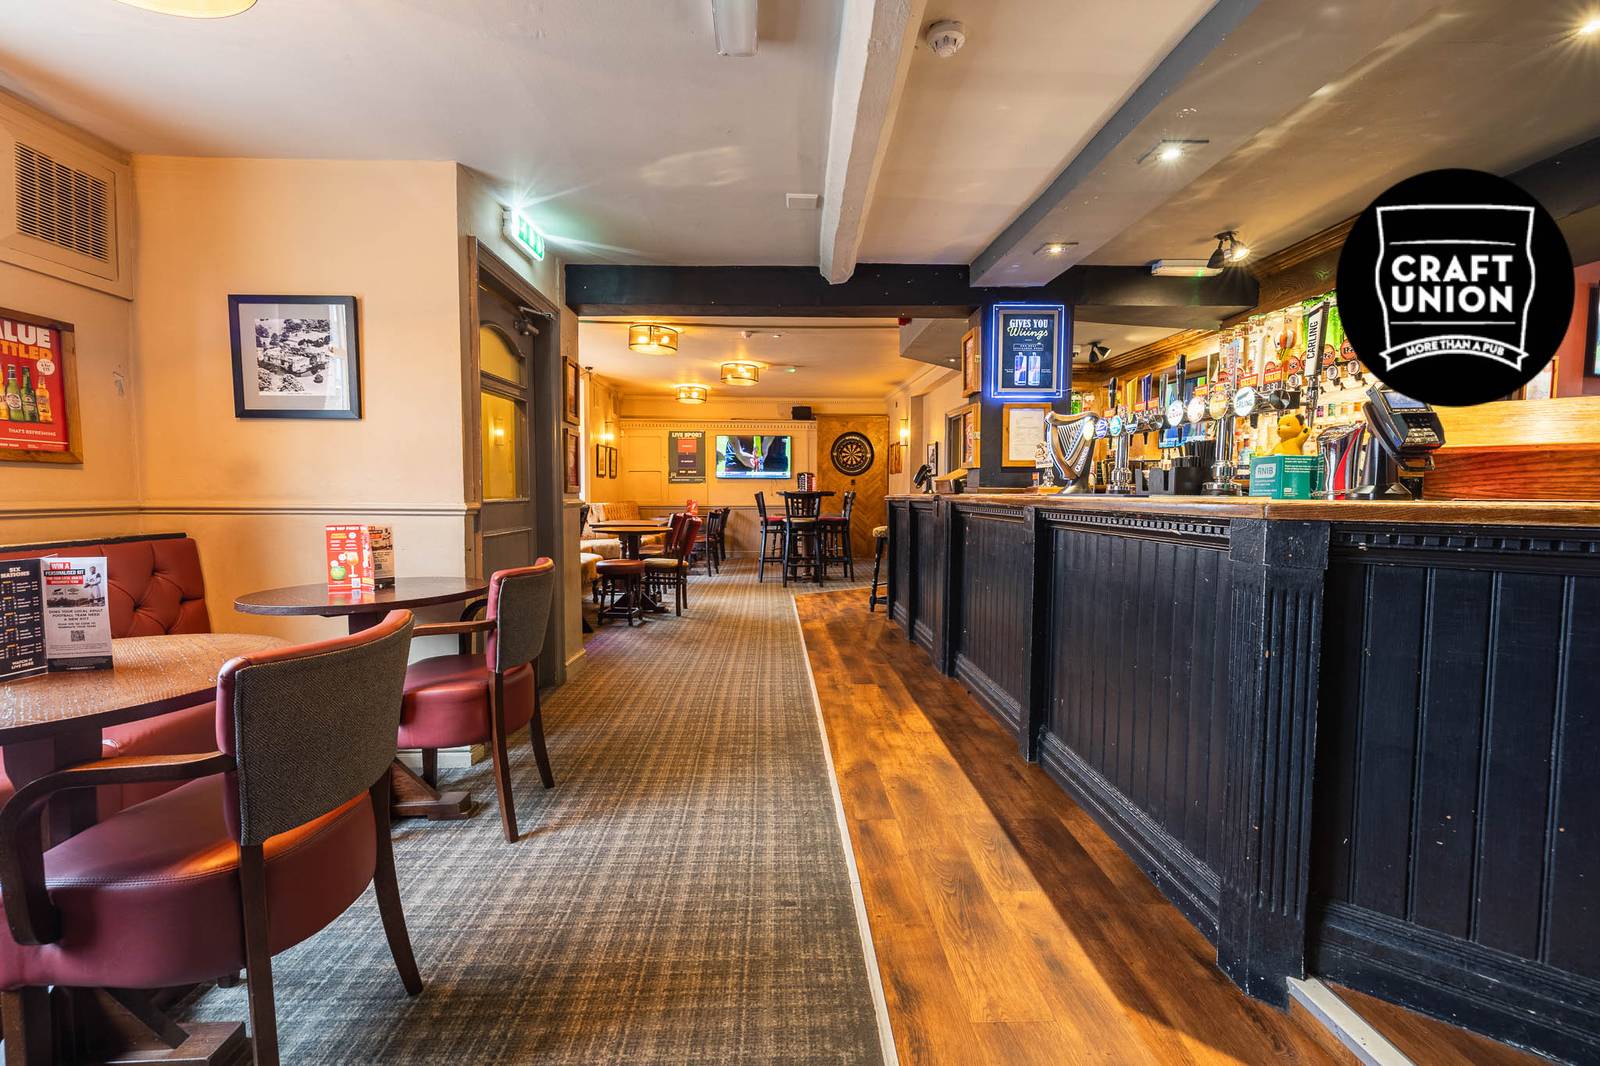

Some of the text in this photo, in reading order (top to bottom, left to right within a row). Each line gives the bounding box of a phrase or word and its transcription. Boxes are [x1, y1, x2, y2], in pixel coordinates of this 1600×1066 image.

[1009, 319, 1048, 328] GIVES YOU
[1306, 320, 1319, 360] CARLING
[1257, 466, 1274, 475] RNIB
[0, 571, 30, 579] NATIONS
